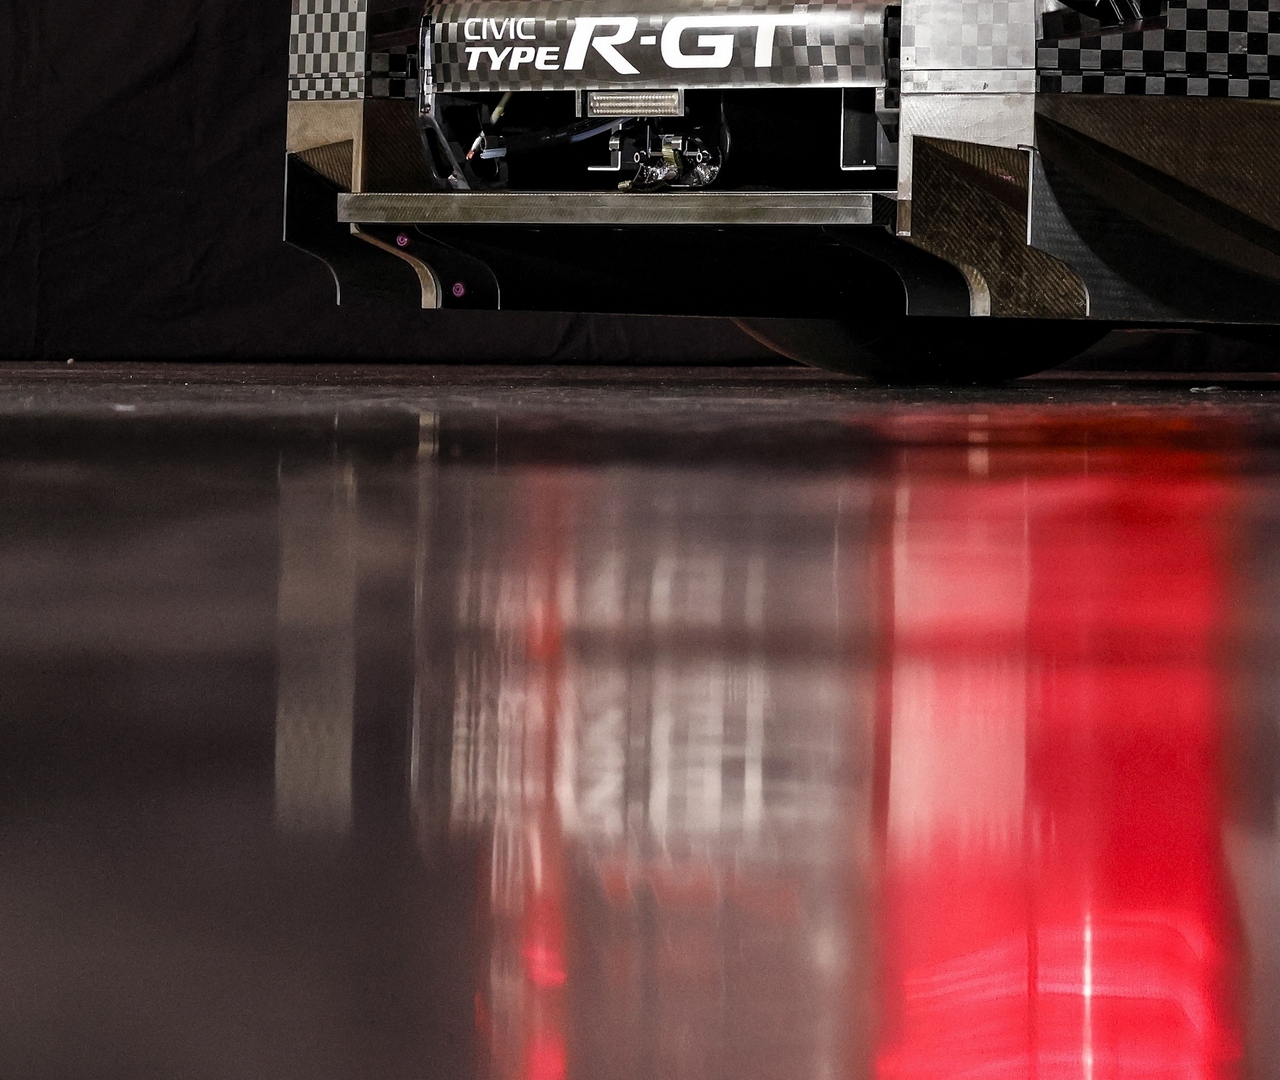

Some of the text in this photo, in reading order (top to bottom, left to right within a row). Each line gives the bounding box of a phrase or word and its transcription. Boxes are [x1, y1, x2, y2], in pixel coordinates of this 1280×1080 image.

[464, 18, 536, 40] CIVIC
[464, 14, 810, 75] TYPE R-GT
